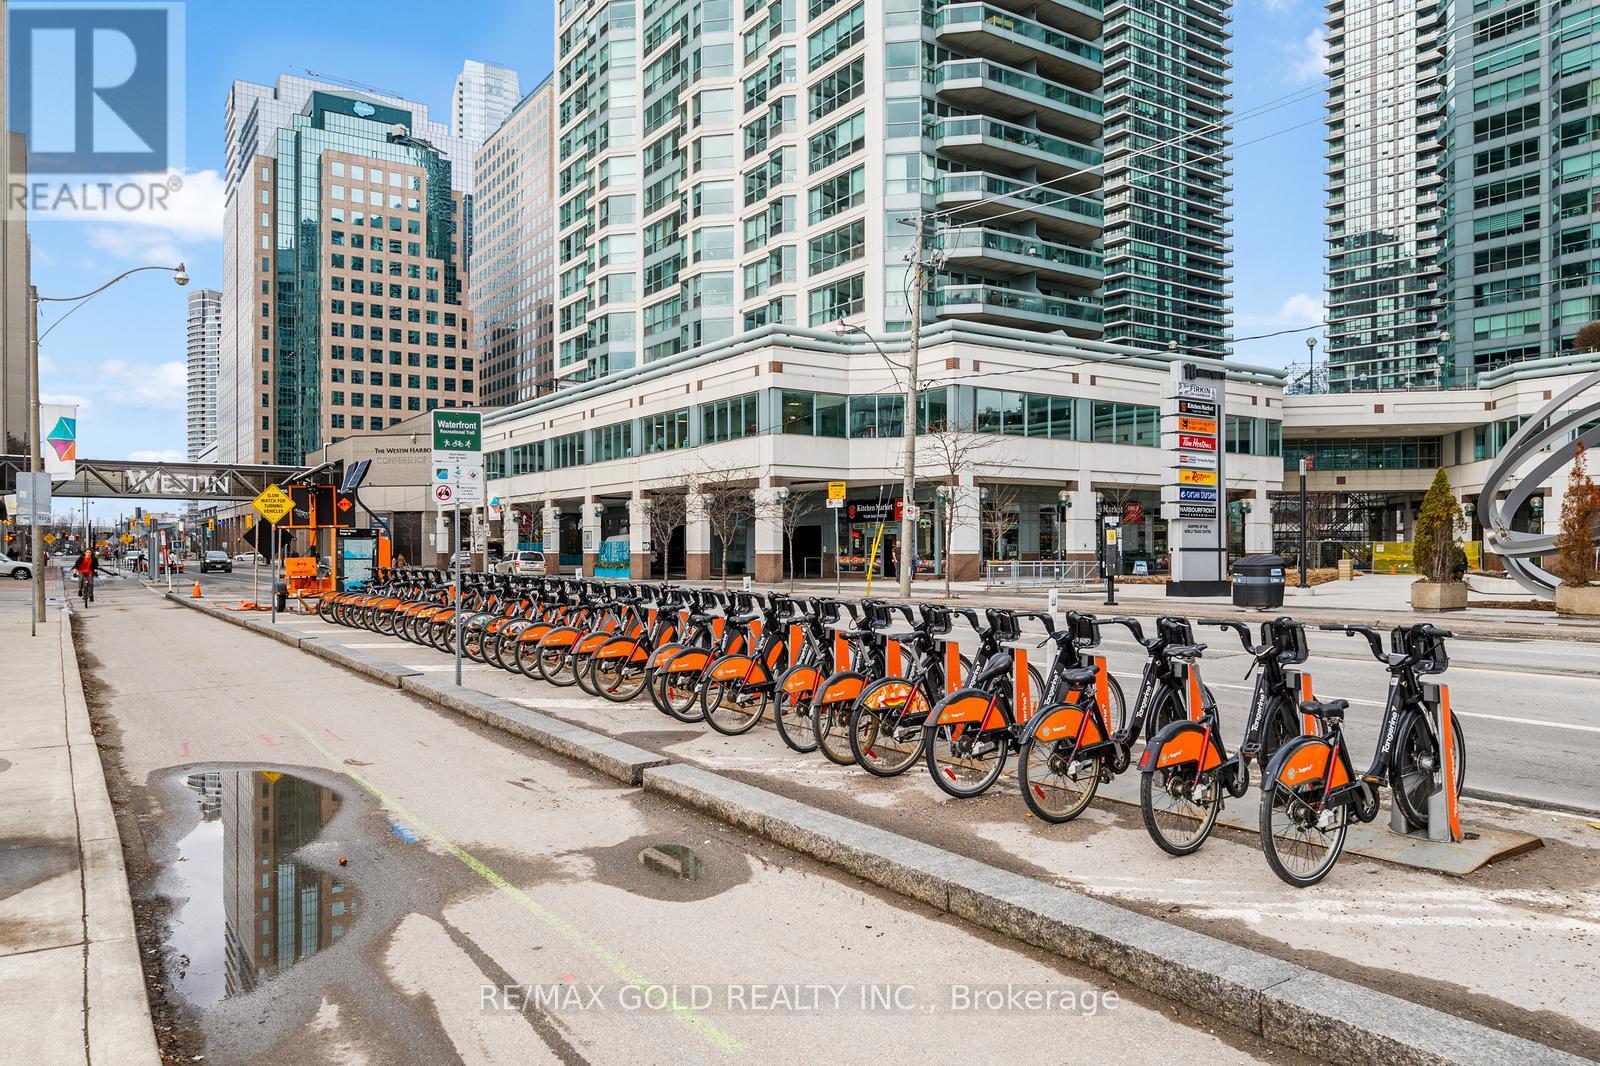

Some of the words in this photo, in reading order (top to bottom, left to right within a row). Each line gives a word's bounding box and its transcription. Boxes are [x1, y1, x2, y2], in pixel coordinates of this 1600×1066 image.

[1190, 386, 1211, 394] FIRKIN
[437, 420, 477, 430] Waterfront
[125, 470, 230, 494] WESTIN
[856, 504, 875, 512] Kitchen
[875, 503, 893, 511] Market
[1180, 506, 1216, 514] HARBOURFRONT
[1043, 673, 1059, 706] Tangerine
[1136, 684, 1152, 718] Tangerine
[1250, 693, 1266, 732] Tangerine
[1381, 710, 1399, 754] Tangerine
